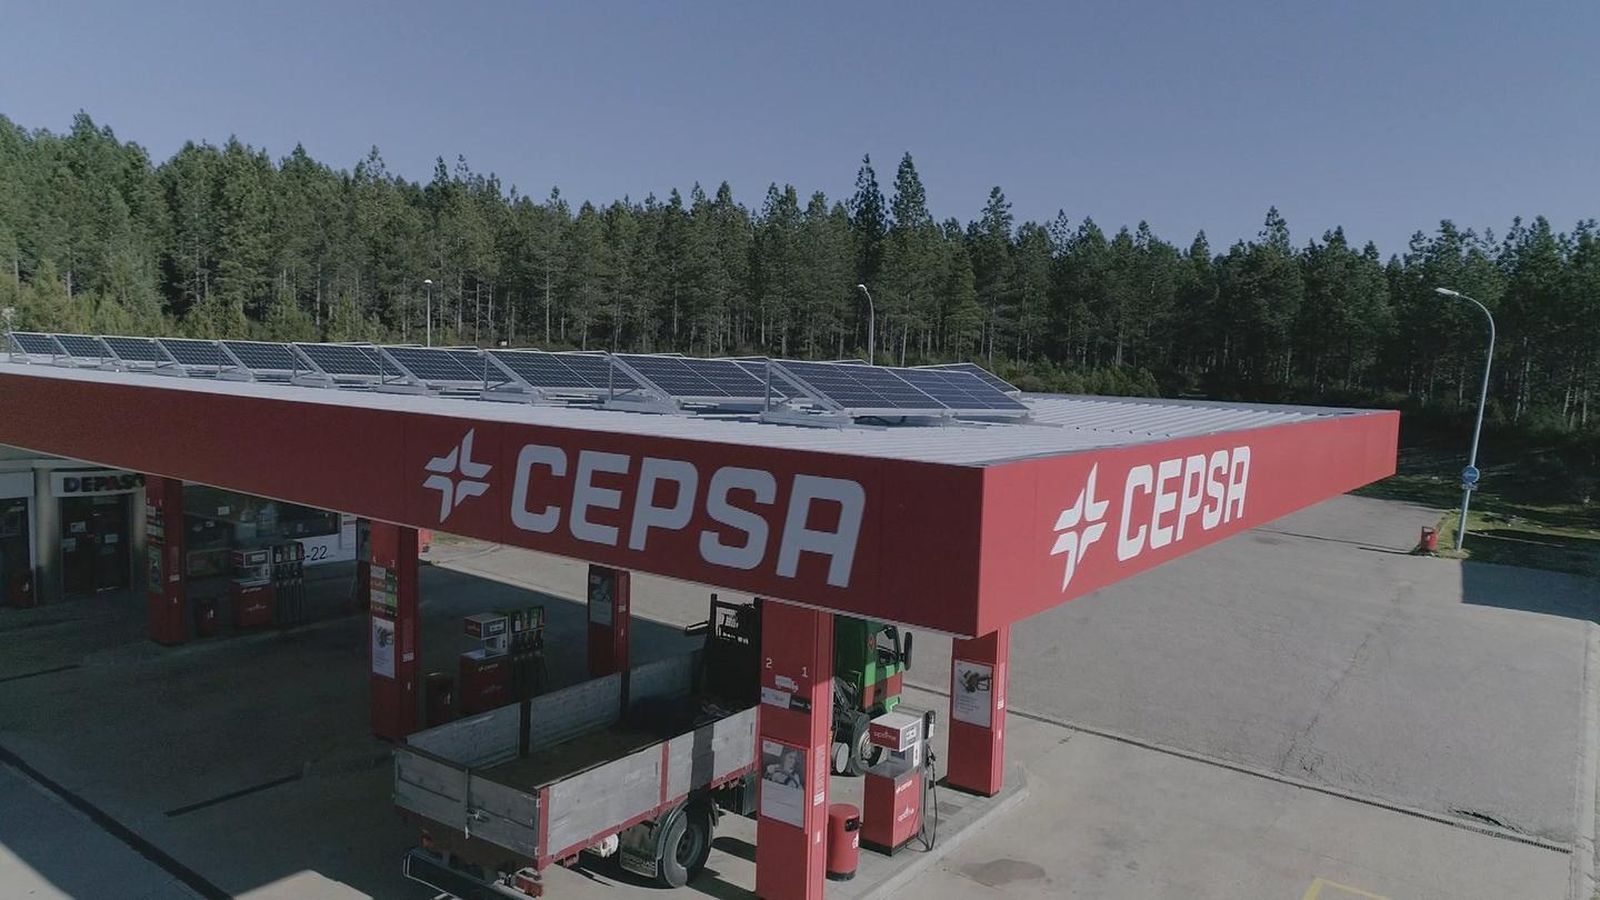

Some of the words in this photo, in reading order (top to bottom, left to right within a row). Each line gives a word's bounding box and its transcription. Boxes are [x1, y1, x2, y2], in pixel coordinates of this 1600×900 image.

[510, 444, 866, 588] CEPSA
[1117, 445, 1251, 562] CEPSA
[764, 657, 773, 669] 2
[801, 666, 810, 678] 1
